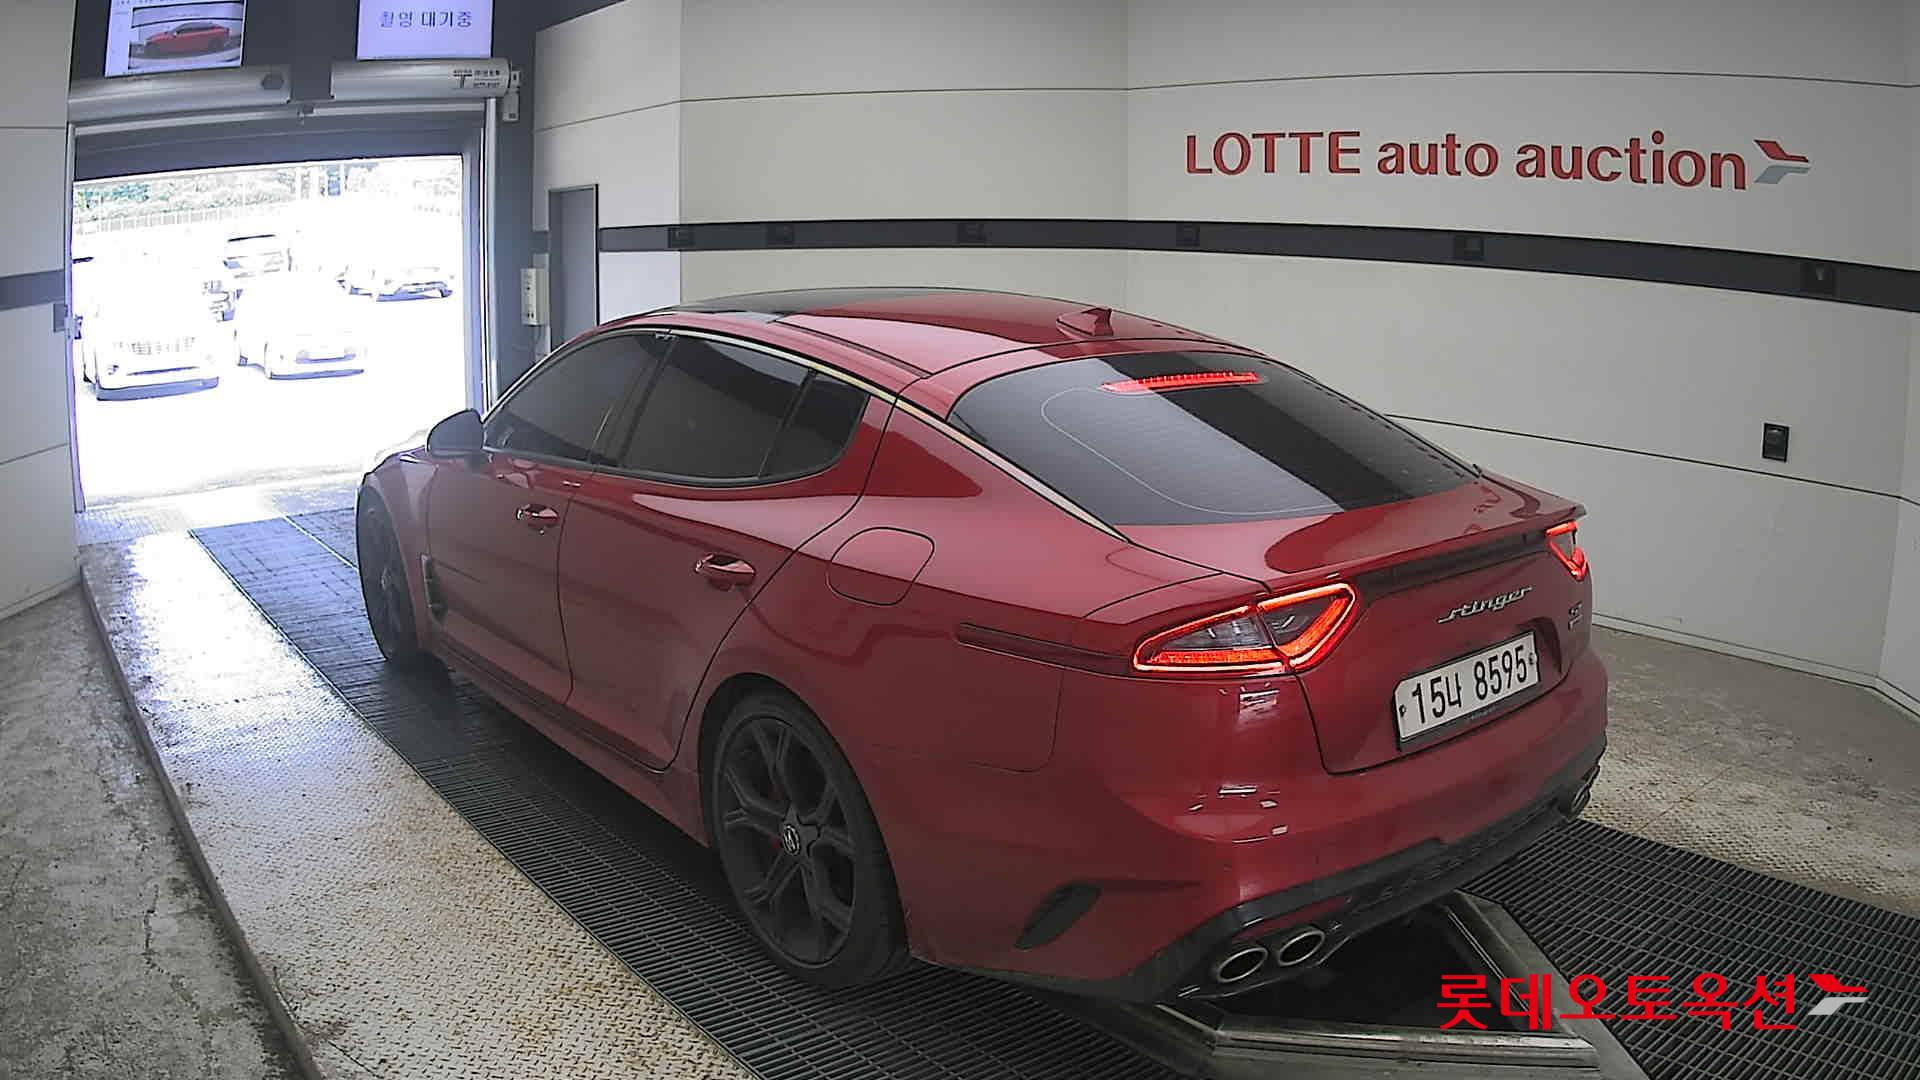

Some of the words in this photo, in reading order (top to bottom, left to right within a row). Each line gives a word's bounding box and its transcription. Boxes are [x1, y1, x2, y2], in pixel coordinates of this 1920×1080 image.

[421, 11, 471, 28] 대기중
[1186, 131, 1361, 175] LOTTE
[1378, 134, 1499, 177] auto
[1515, 131, 1748, 190] auction
[1412, 673, 1462, 723] 15나
[1473, 645, 1528, 700] 8595
